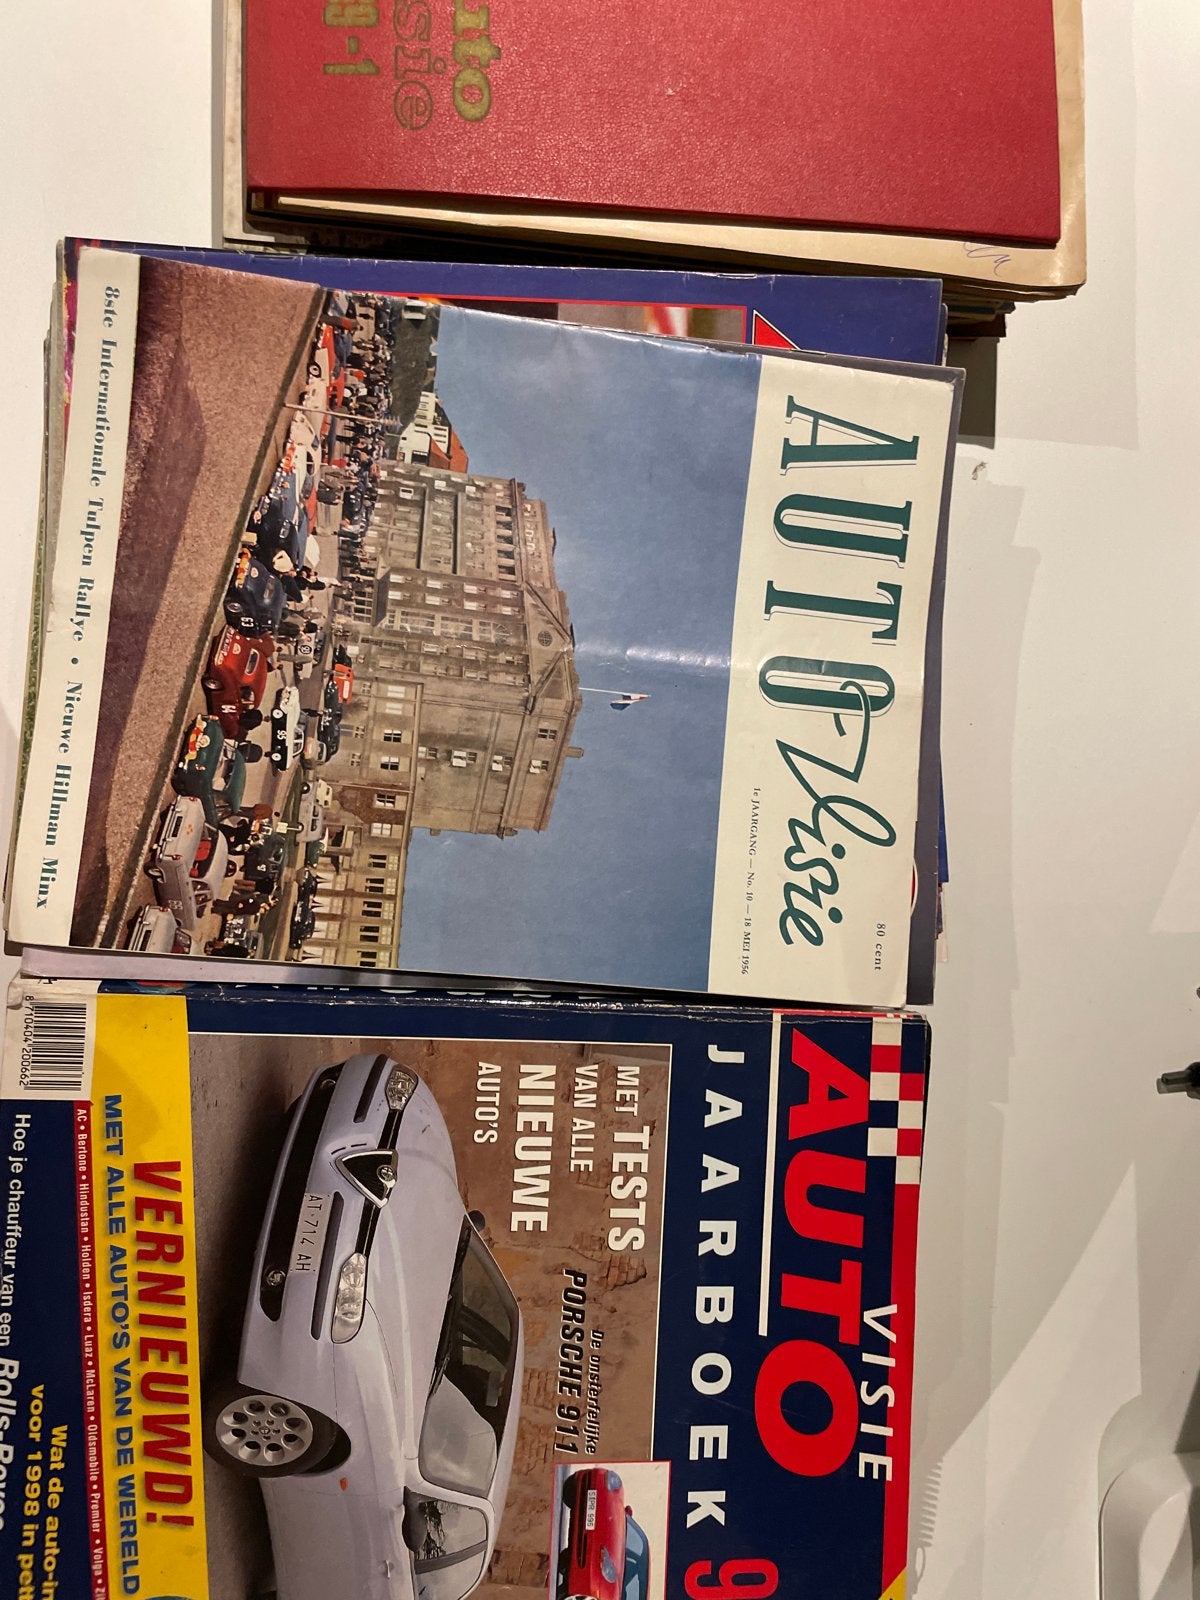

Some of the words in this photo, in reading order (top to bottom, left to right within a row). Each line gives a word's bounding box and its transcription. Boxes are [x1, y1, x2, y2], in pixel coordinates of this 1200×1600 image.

[103, 286, 121, 328] 8ste
[89, 338, 118, 488] Internationale
[79, 497, 105, 566] Tulpen
[759, 396, 919, 717] AUTO
[69, 577, 95, 642] Rallye
[240, 617, 254, 628] 63
[57, 680, 83, 754] Nieuwe
[221, 704, 237, 714] 64
[45, 764, 72, 846] Hillman
[748, 799, 760, 856] JAARGANG
[776, 681, 897, 947] Visie
[35, 856, 59, 910] Minx
[745, 891, 754, 901] 10
[746, 872, 755, 888] No.
[742, 931, 751, 952] MEI
[743, 917, 752, 927] 18
[874, 923, 887, 938] 80
[741, 955, 750, 975] 1956
[873, 942, 884, 972] cent
[22, 1005, 35, 1044] 710404
[19, 1048, 32, 1087] 200662
[572, 1063, 598, 1109] VAN
[614, 1065, 640, 1117] MET
[76, 1108, 88, 1122] AC
[104, 1094, 124, 1155] MET
[473, 1061, 502, 1145] AUTO'S
[13, 1114, 31, 1151] Hoe
[77, 1133, 89, 1172] Bertone
[509, 1064, 557, 1233] NIEUWE
[569, 1117, 595, 1173] ALLE
[8, 1156, 27, 1174] je
[606, 1125, 651, 1253] TESTS
[3, 1179, 25, 1269] chauffeur
[78, 1183, 90, 1233] Hindustan
[106, 1166, 127, 1235] ALLE
[81, 1244, 92, 1280] Holden
[295, 1254, 312, 1271] AH
[754, 1027, 869, 1477] AUTO
[0, 1273, 15, 1307] van
[82, 1291, 94, 1323] Isdera
[109, 1245, 130, 1349] AUTO'S
[686, 1044, 745, 1529] JAARBOEK
[0, 1312, 12, 1347] een
[84, 1334, 95, 1358] Luaz
[133, 1161, 194, 1526] VERNIEUWD!
[556, 1269, 588, 1397] PORSCHE
[589, 1330, 605, 1351] De
[85, 1369, 97, 1413] McLaren
[113, 1357, 133, 1417] VAN
[583, 1355, 604, 1455] onsterfelijke
[858, 1305, 897, 1481] VISIE
[28, 1385, 45, 1442] voor
[553, 1404, 585, 1455] 911
[48, 1425, 69, 1471] Wat
[87, 1424, 99, 1481] Oldsmobile
[115, 1427, 134, 1466] DE
[23, 1451, 43, 1516] 1998
[47, 1478, 64, 1509] de
[21, 1523, 40, 1547] in
[90, 1492, 101, 1533] Premier
[117, 1474, 140, 1595] WERELD
[92, 1547, 104, 1576] Volga
